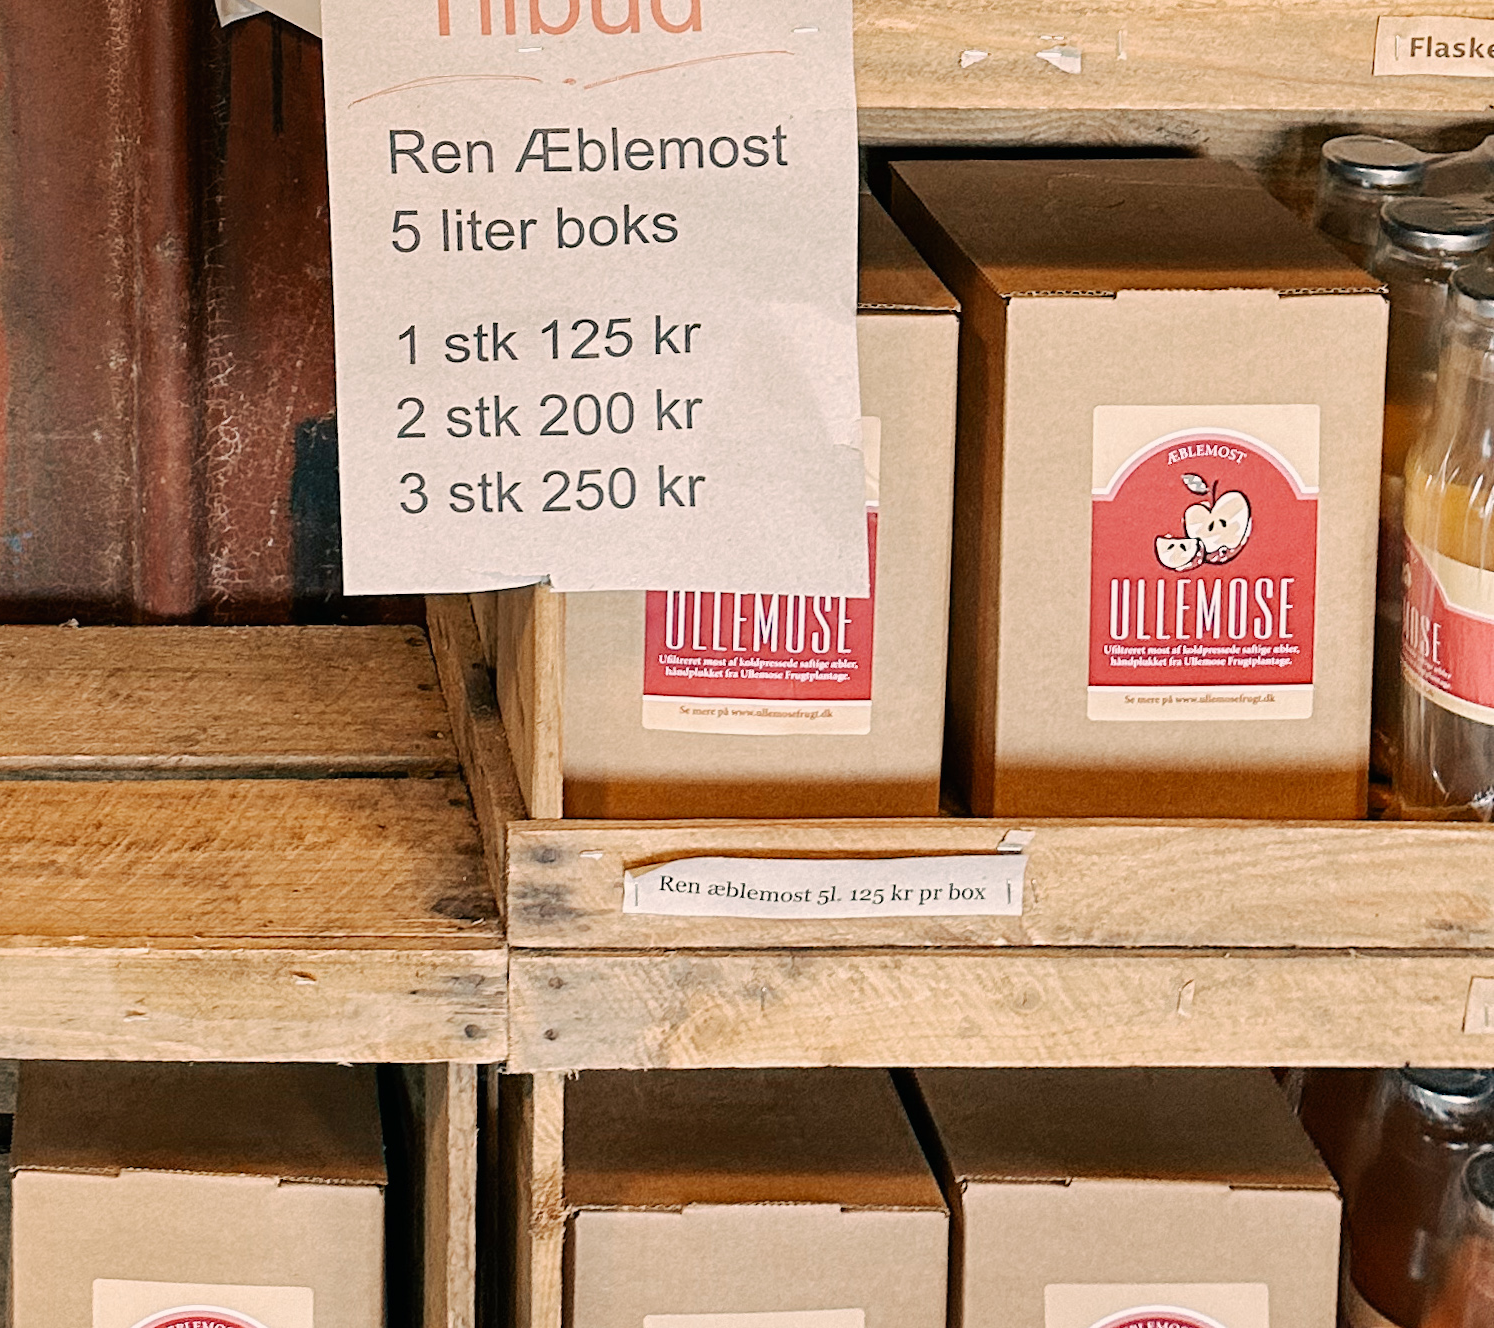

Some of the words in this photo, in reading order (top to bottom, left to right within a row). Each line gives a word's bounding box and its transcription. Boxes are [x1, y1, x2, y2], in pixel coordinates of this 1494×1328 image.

[388, 128, 495, 176] Ren
[515, 124, 789, 173] Æblemost
[390, 209, 422, 254] 5
[442, 208, 538, 253] liter
[556, 203, 680, 250] boks
[398, 323, 420, 365] 1
[444, 322, 520, 363] stk
[541, 317, 635, 361] 125
[654, 314, 703, 356] kr
[396, 396, 427, 439] 2
[445, 395, 522, 438] stk
[538, 391, 636, 437] 200
[655, 388, 704, 432] kr
[1166, 443, 1248, 466] ÆBLEMOST
[398, 472, 430, 515] 3
[448, 470, 525, 514] stk
[541, 466, 638, 513] 250
[658, 465, 707, 510] kr
[665, 591, 852, 654] ULLEMOSE
[1109, 577, 1295, 641] ULLEMOSE
[703, 657, 727, 667] most
[728, 656, 738, 667] af
[1148, 646, 1170, 655] most
[1172, 645, 1182, 655] af
[1183, 645, 1241, 656] koldpressede
[1242, 645, 1271, 657] saftige
[1168, 656, 1182, 667] fra
[1184, 656, 1227, 667] Ullemose
[725, 668, 739, 679] fra
[740, 668, 783, 679] Ullemose
[680, 705, 690, 715] Se
[692, 707, 716, 715] mere
[718, 707, 729, 718] på
[1124, 695, 1136, 704] Se
[1137, 696, 1160, 704] mere
[1162, 695, 1173, 706] på
[1175, 693, 1276, 705] www.ullemosefrugt.dk
[659, 874, 701, 896] Ren
[707, 880, 813, 904] æblemost
[850, 885, 885, 906] 125
[890, 885, 915, 903] kr
[919, 885, 943, 907] pr
[949, 881, 987, 901] box
